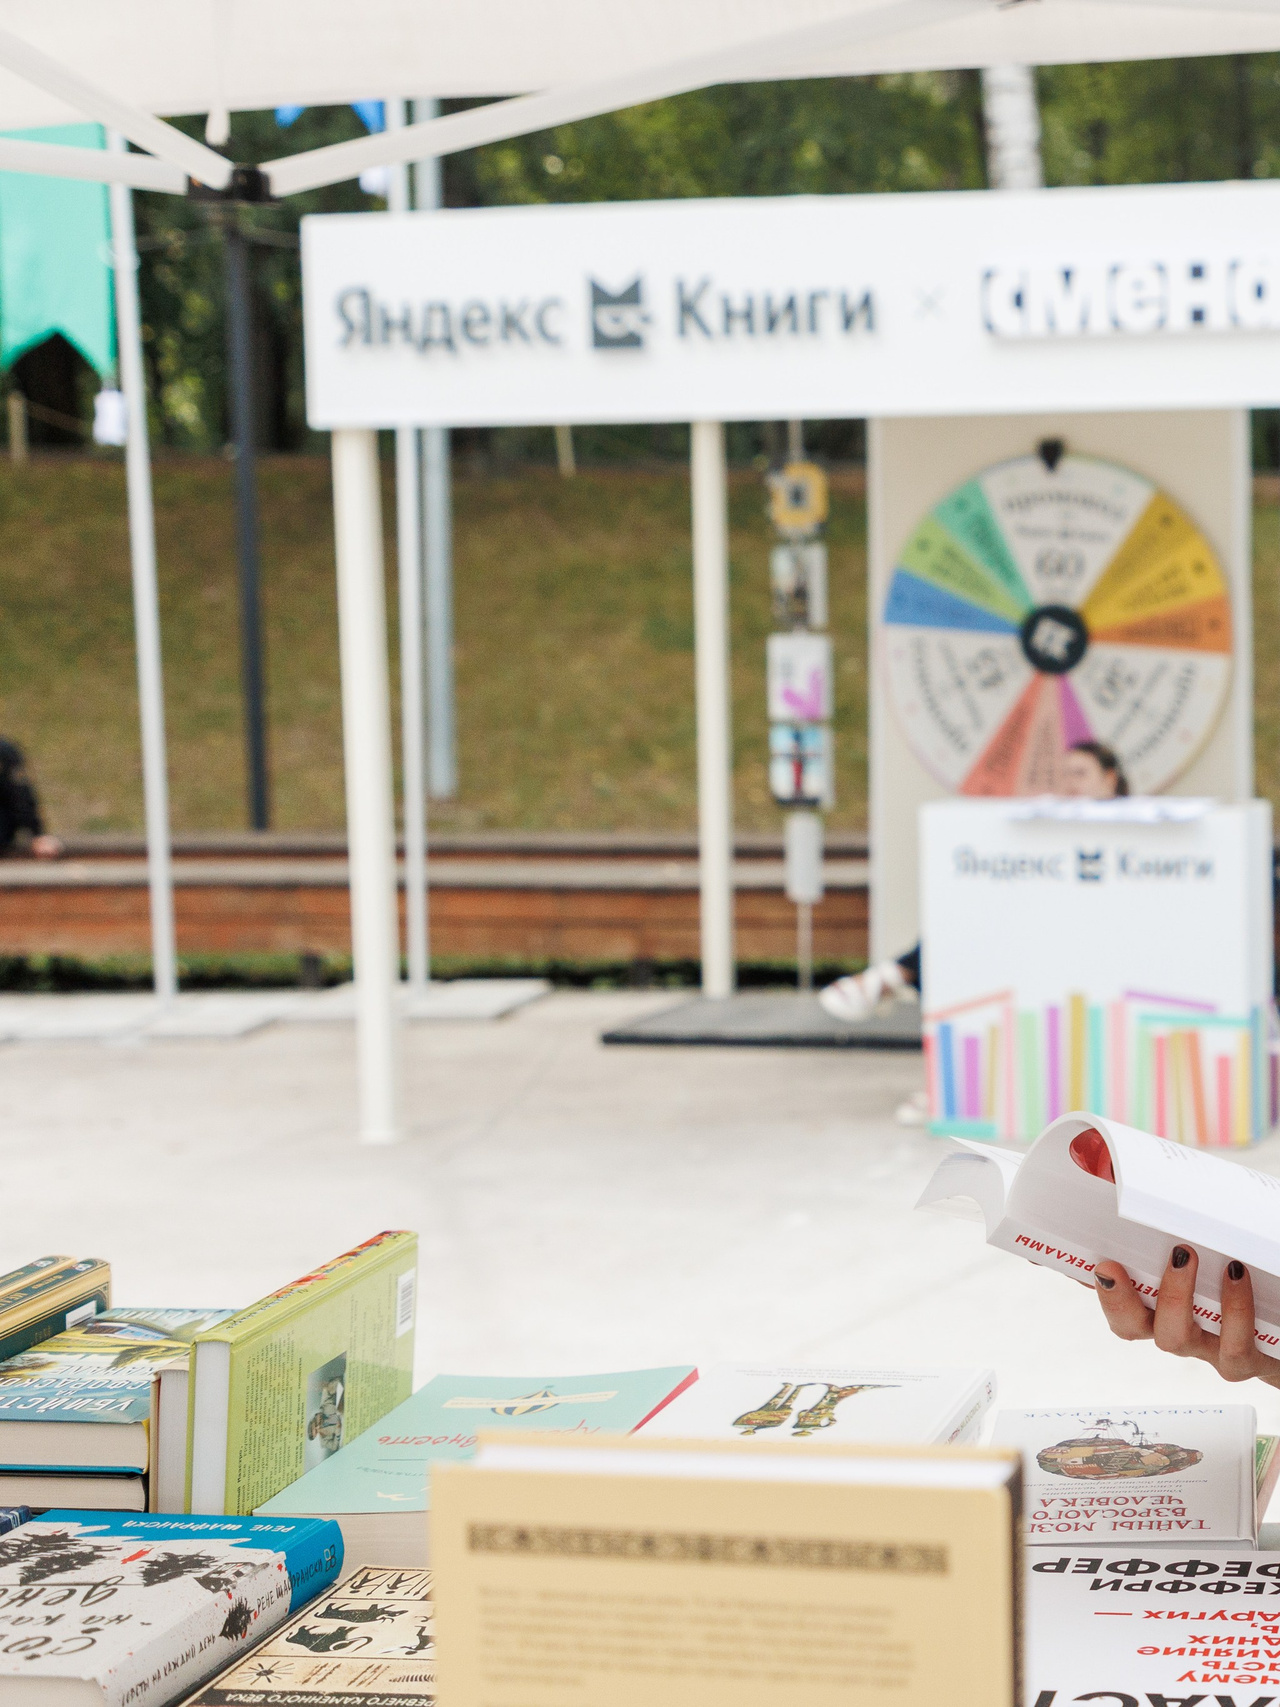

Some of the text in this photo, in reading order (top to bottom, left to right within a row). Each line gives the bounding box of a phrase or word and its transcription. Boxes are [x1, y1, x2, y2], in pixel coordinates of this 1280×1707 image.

[334, 275, 878, 356] Яндекс Книги
[952, 846, 1213, 884] Яндекс Книги
[1014, 1233, 1096, 1272] РЕКЛАМЫ
[0, 1377, 151, 1390] СФОРДСКО
[0, 1396, 137, 1413] УБИЙСТ
[1024, 1409, 1223, 1419] БАРБАРА СТРАУК
[1040, 1494, 1184, 1508] ЧЕЛОВЕКА
[1032, 1507, 1188, 1520] ВЗРОСЛОГО
[121, 1520, 296, 1533] РЕНЕ ШАФРАНСКИ
[1024, 1519, 1211, 1533] ТАЙНЫ МОЗГ
[256, 1589, 275, 1614] РЕНЕ
[0, 1634, 97, 1656] Со
[226, 1692, 436, 1707] РЕВНЕГО КАМЕННОГО ВЕКА
